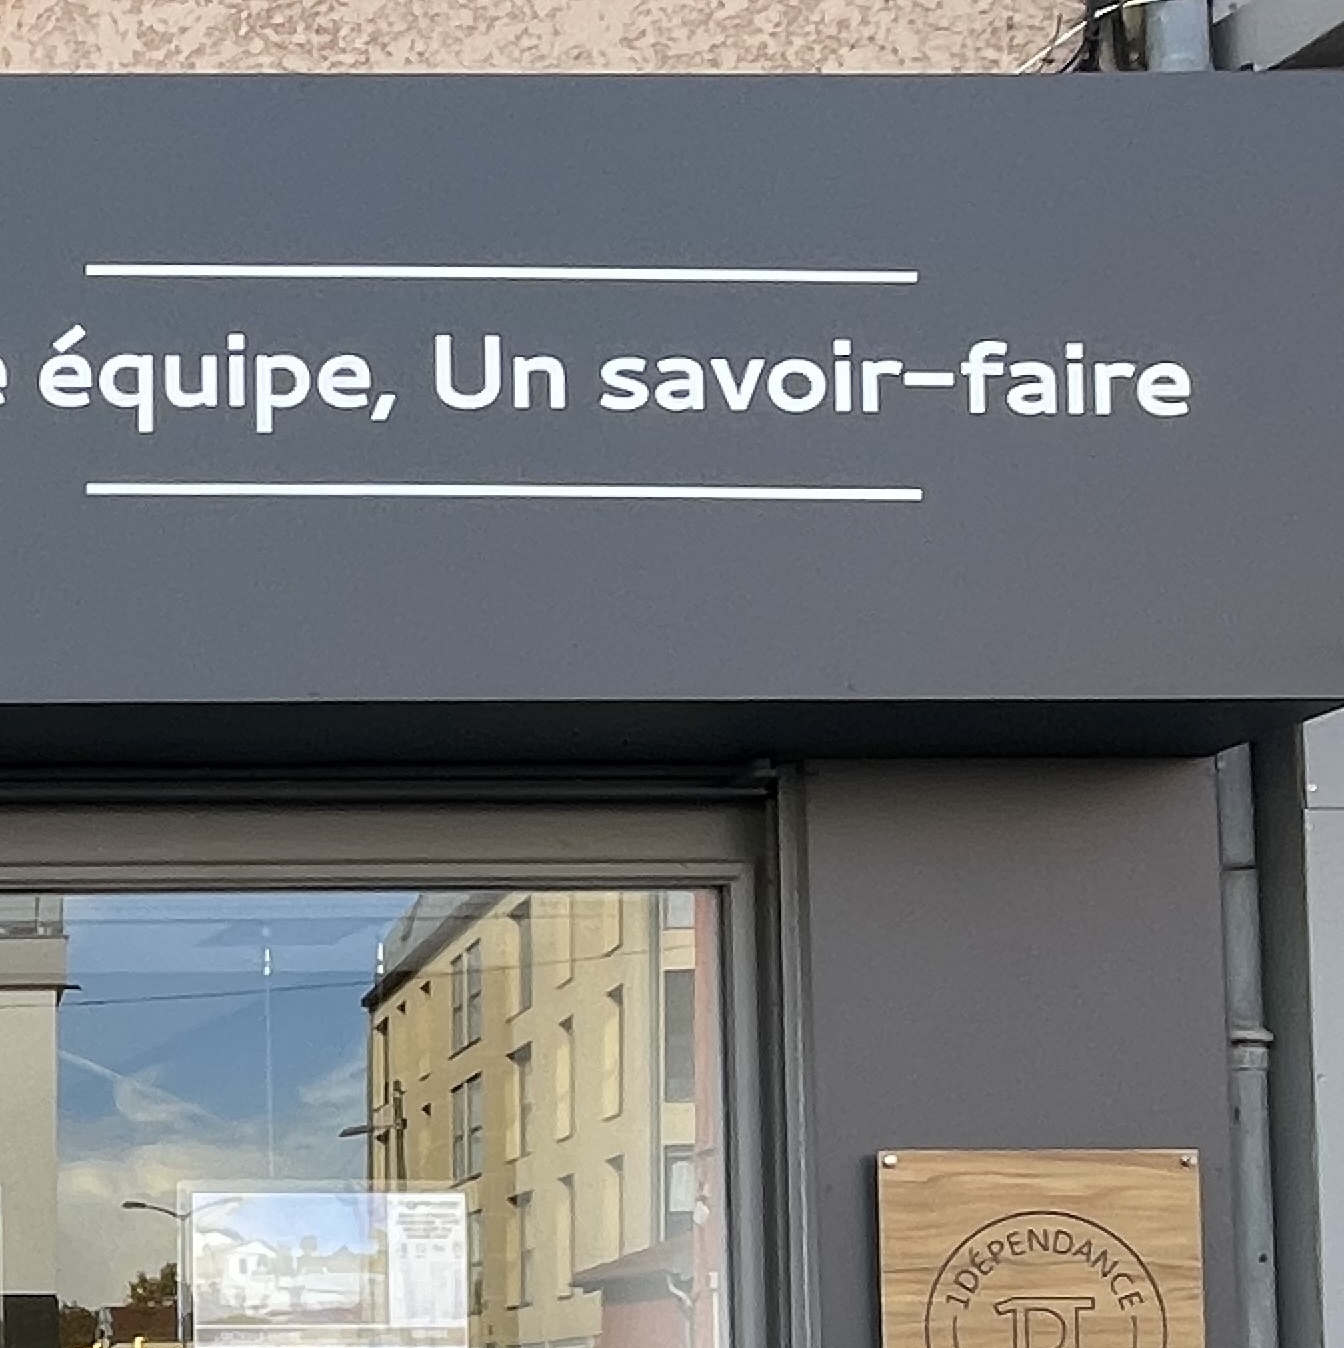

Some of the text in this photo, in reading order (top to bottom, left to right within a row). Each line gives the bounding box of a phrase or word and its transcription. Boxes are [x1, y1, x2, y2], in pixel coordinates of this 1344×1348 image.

[38, 324, 397, 433] équipe,
[434, 334, 567, 411] Un
[600, 339, 1192, 417] savoir-faire
